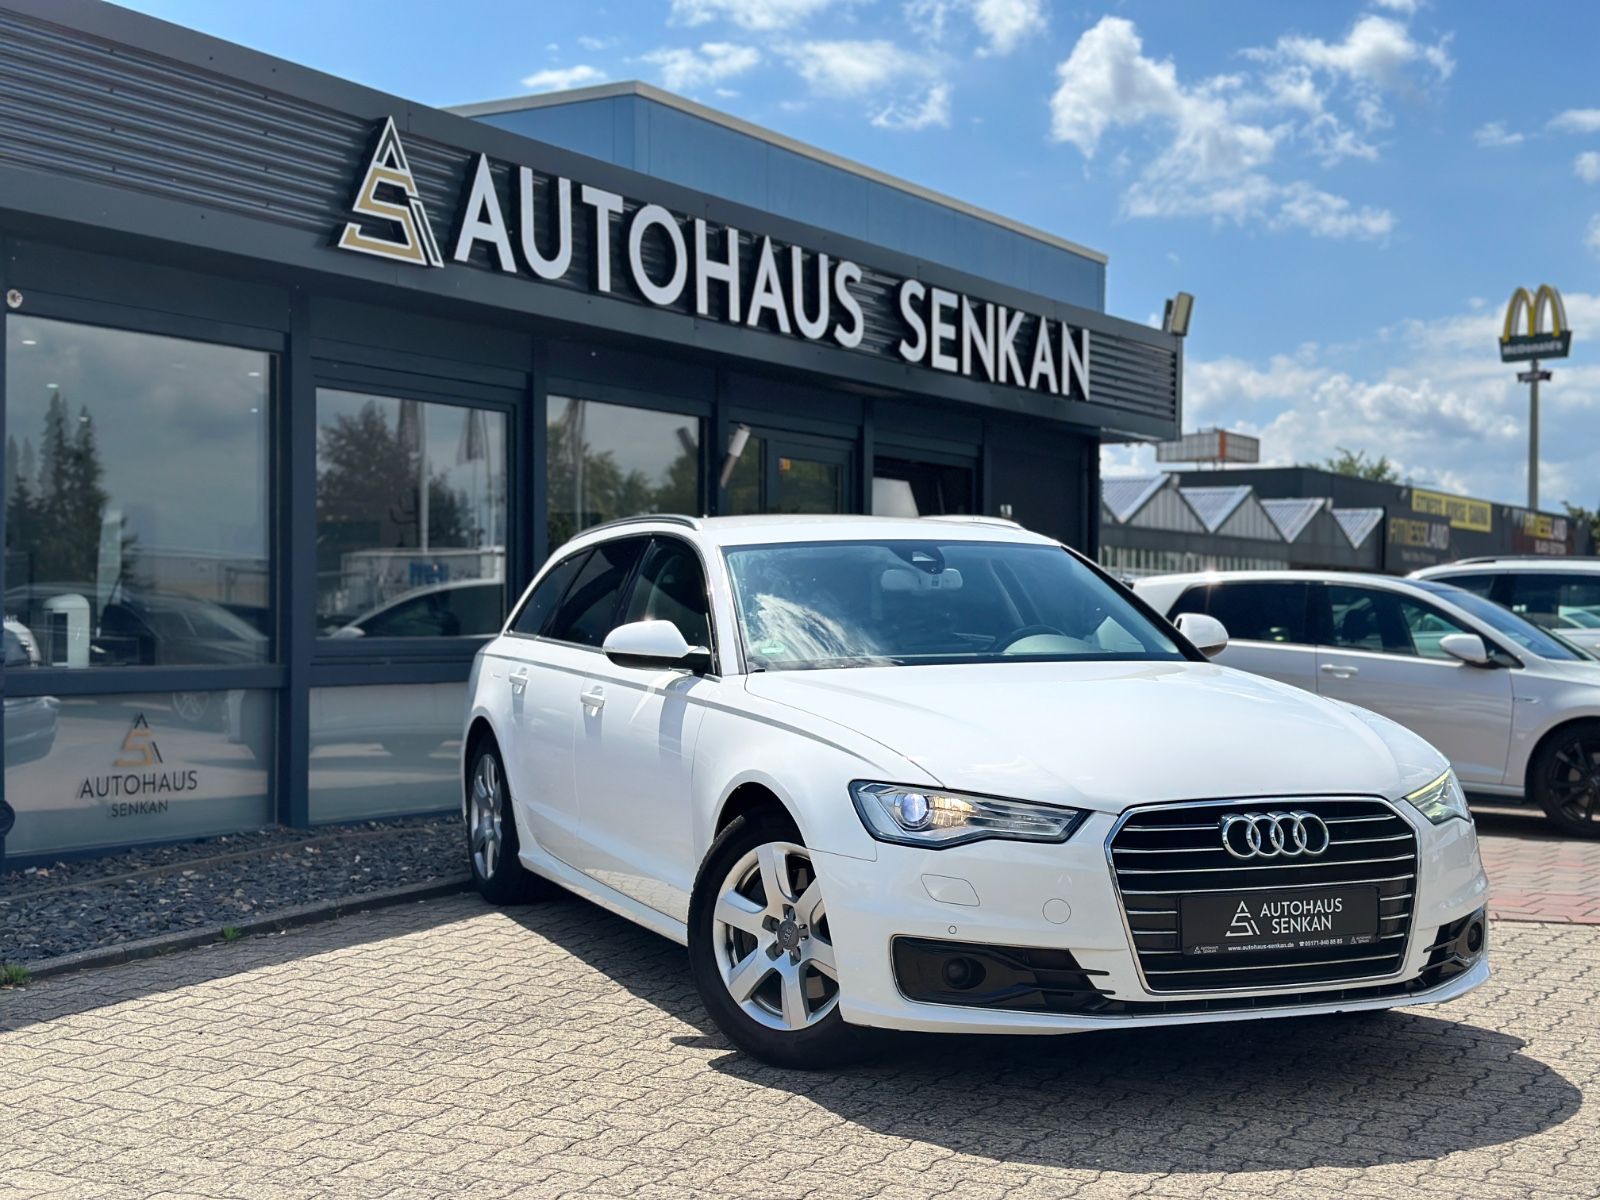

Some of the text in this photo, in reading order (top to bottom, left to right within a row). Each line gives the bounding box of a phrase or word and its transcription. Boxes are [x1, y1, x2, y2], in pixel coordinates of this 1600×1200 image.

[454, 152, 864, 348] AUTOHAUS
[899, 279, 1090, 401] SENKAN
[79, 770, 198, 799] AUTOHAUS
[111, 800, 168, 818] SENKAN
[1260, 898, 1343, 917] AUTOHAUS
[1271, 915, 1332, 935] SENKAN
